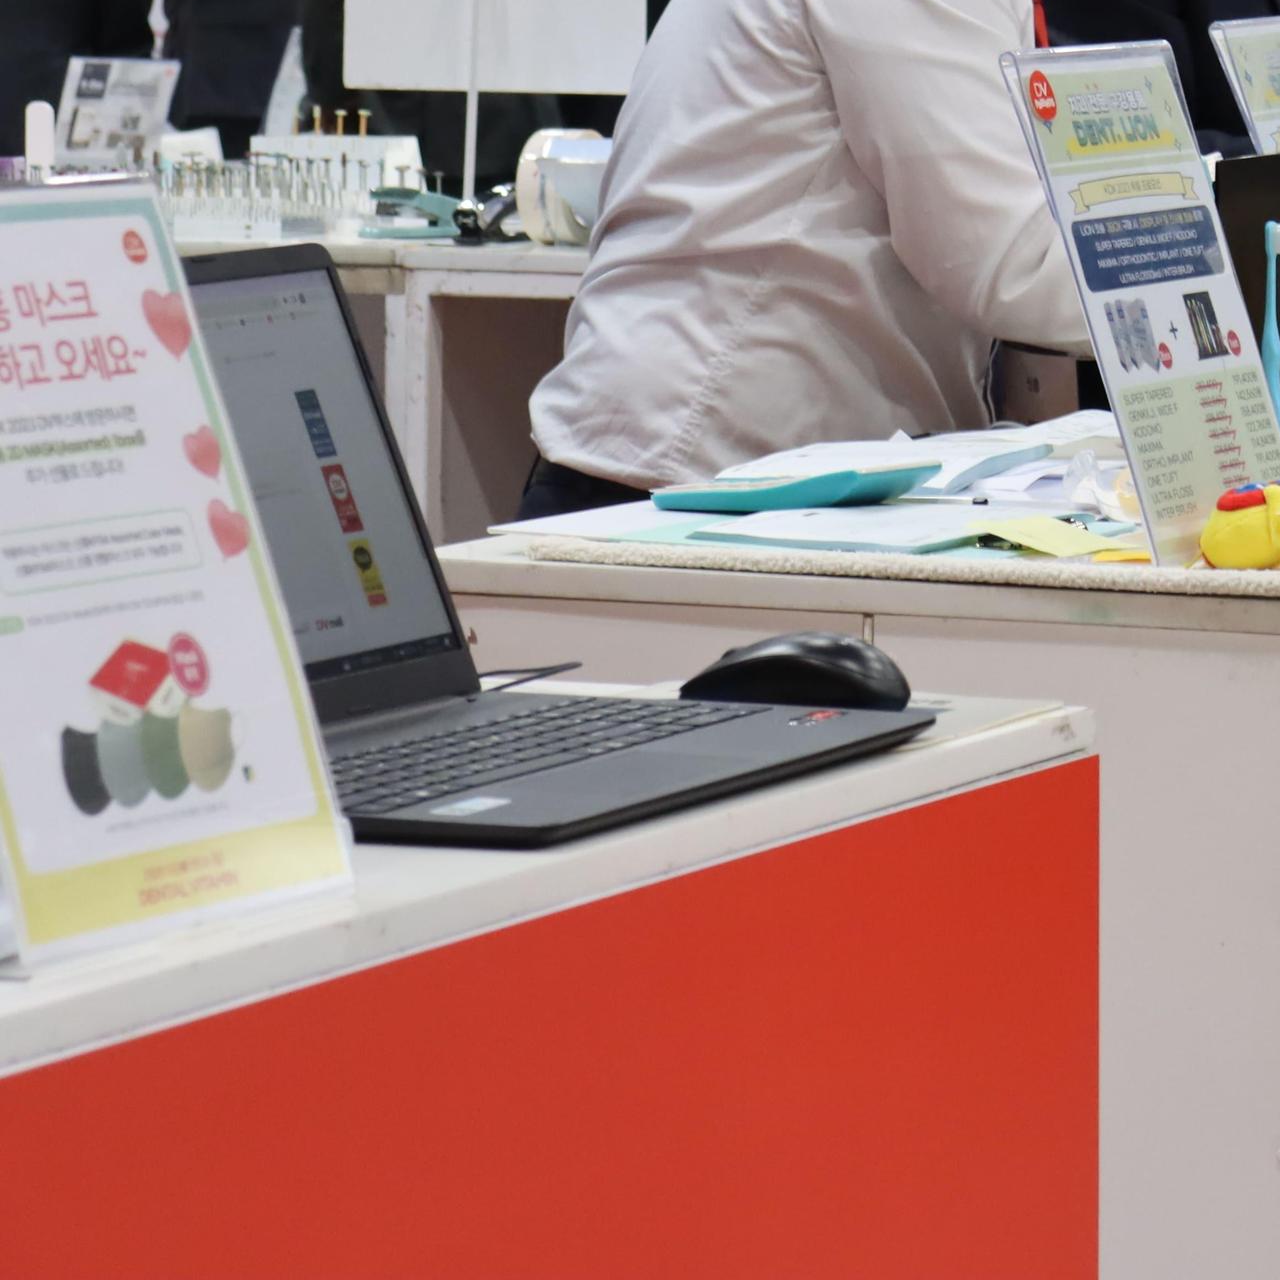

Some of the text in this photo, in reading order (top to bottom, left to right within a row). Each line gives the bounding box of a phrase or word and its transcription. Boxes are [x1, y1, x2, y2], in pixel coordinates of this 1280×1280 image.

[1033, 82, 1047, 97] DV
[1121, 113, 1161, 142] LION
[13, 281, 98, 326] 마스크
